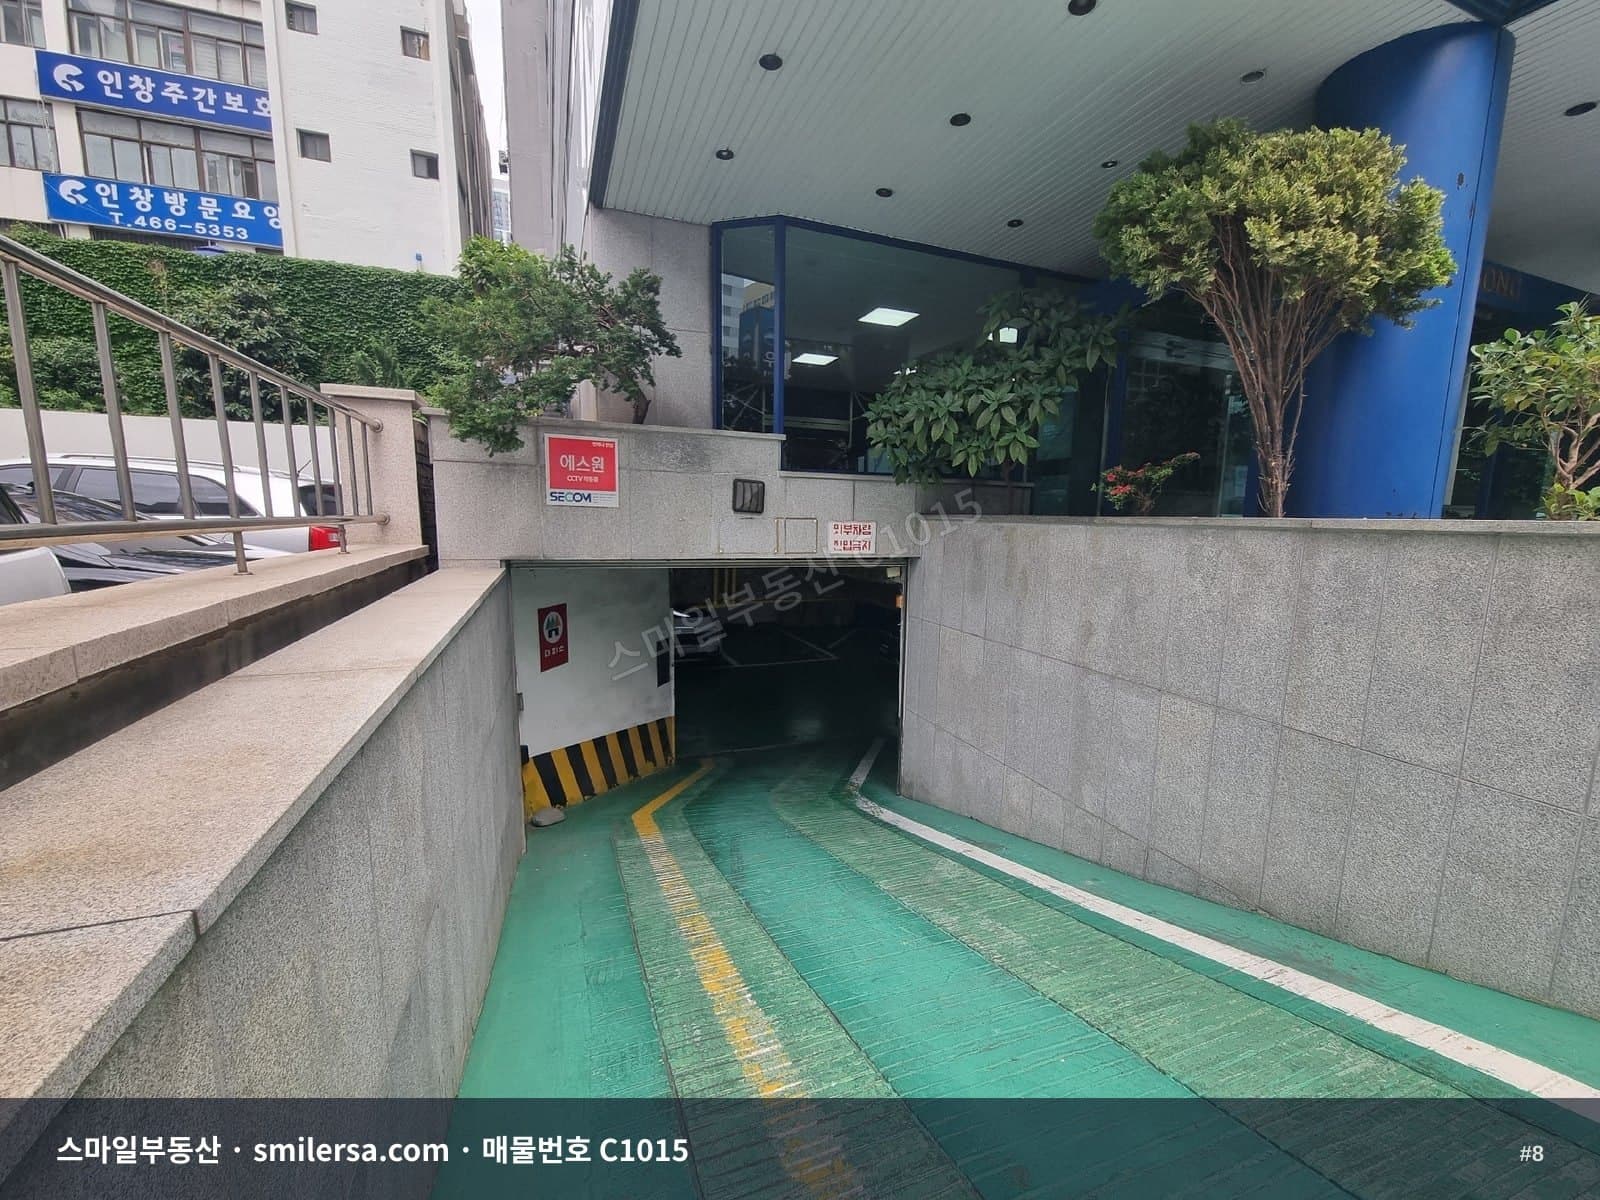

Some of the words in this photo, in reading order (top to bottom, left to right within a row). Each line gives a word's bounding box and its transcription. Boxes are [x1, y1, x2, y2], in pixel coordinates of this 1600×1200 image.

[109, 212, 248, 239] T.466-5353
[560, 455, 604, 472] 에스원
[550, 492, 591, 502] SECOM
